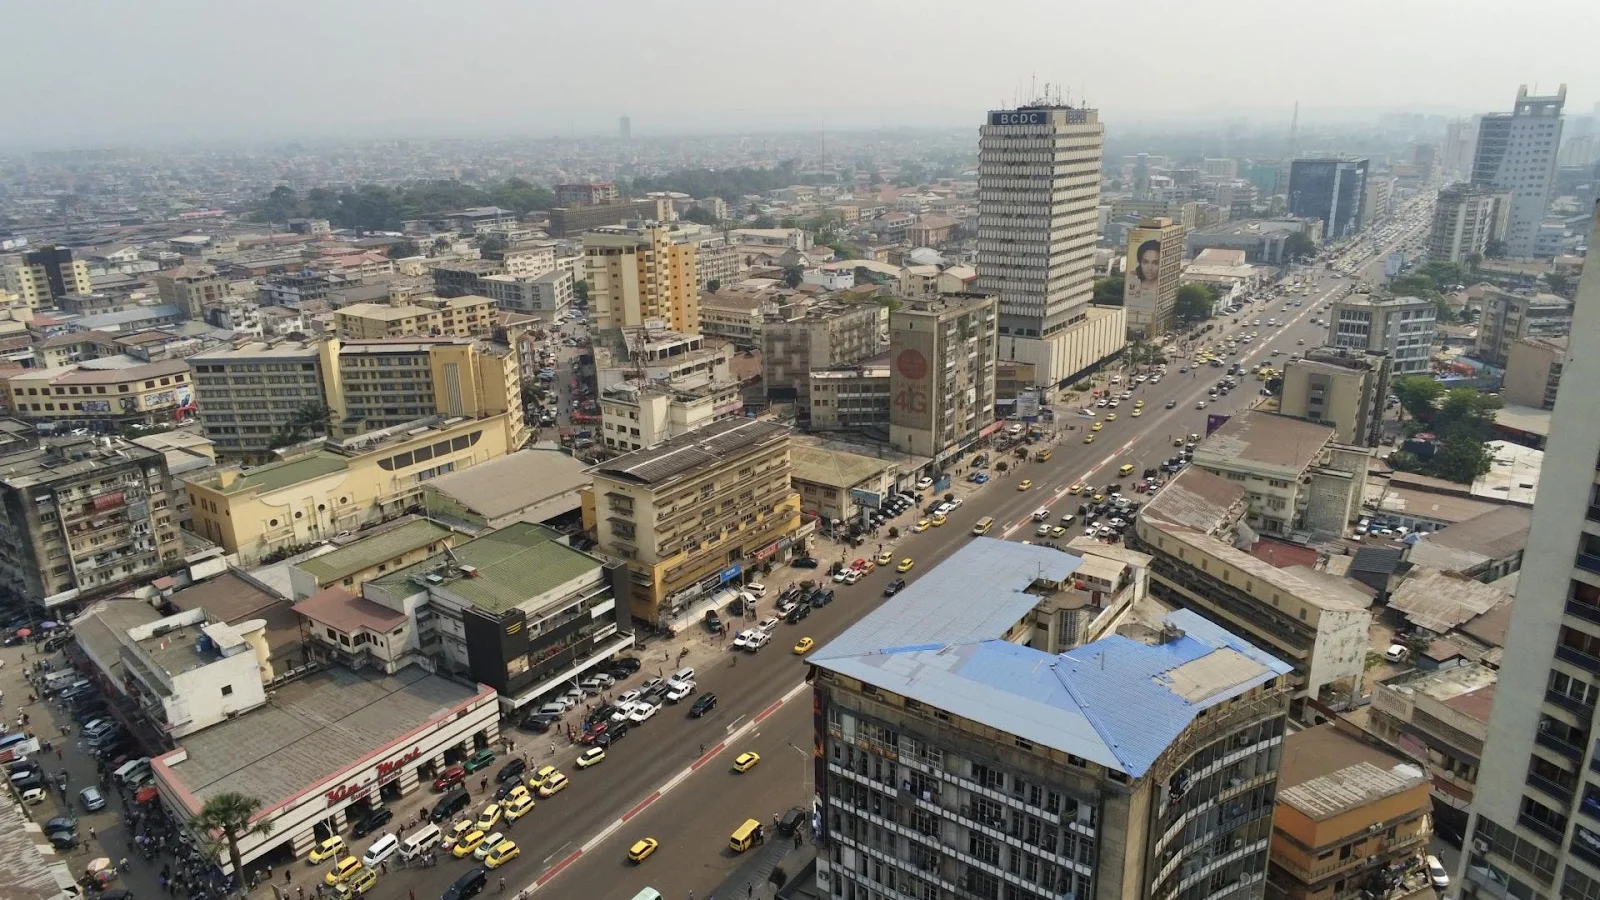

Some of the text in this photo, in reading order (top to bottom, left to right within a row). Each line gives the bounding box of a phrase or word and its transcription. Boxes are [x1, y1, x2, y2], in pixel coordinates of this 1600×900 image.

[1001, 113, 1038, 124] BCDC
[893, 390, 927, 414] 4G
[325, 783, 361, 808] Kin
[375, 746, 422, 779] Mart
[350, 786, 372, 802] Super
